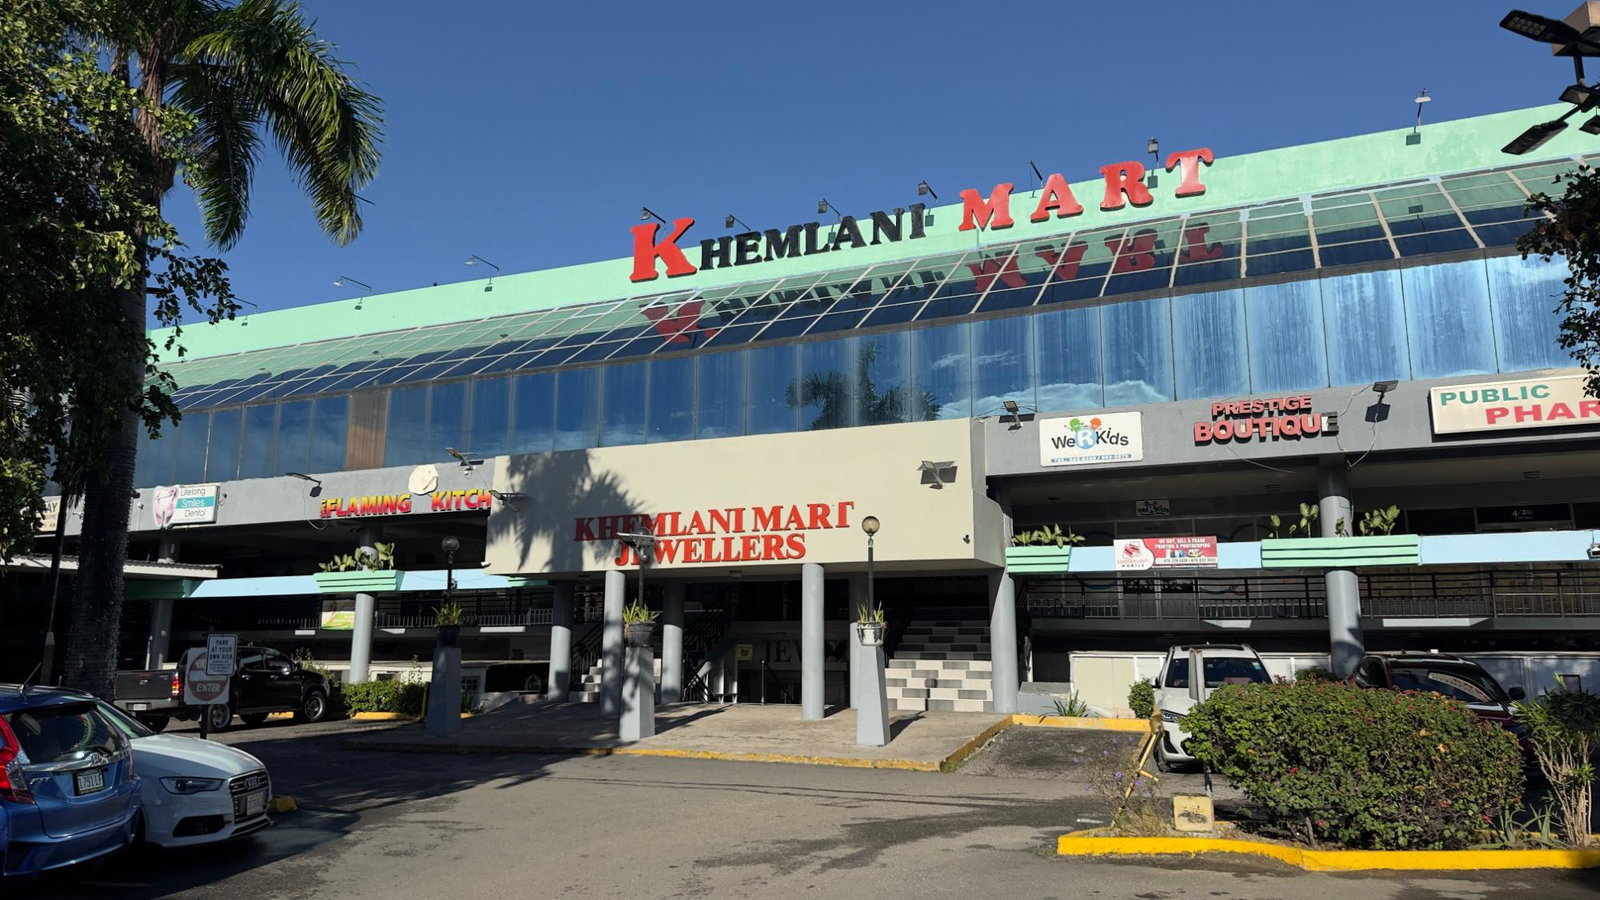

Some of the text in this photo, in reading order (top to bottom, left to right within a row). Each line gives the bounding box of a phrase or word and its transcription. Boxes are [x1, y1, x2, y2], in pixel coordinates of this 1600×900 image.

[630, 147, 1215, 283] KHEMLANI MART
[1211, 395, 1312, 419] PRESTIGE
[1440, 384, 1550, 406] PUBLIC
[1485, 399, 1600, 425] PHAR
[1051, 427, 1129, 450] We R Kids
[1193, 411, 1339, 444] BOUTIQUE
[181, 499, 205, 507] Smiles
[184, 509, 206, 517] Dental
[326, 493, 412, 517] FLAMING
[431, 488, 492, 511] KITCH
[574, 501, 855, 541] KHEMLANI MART
